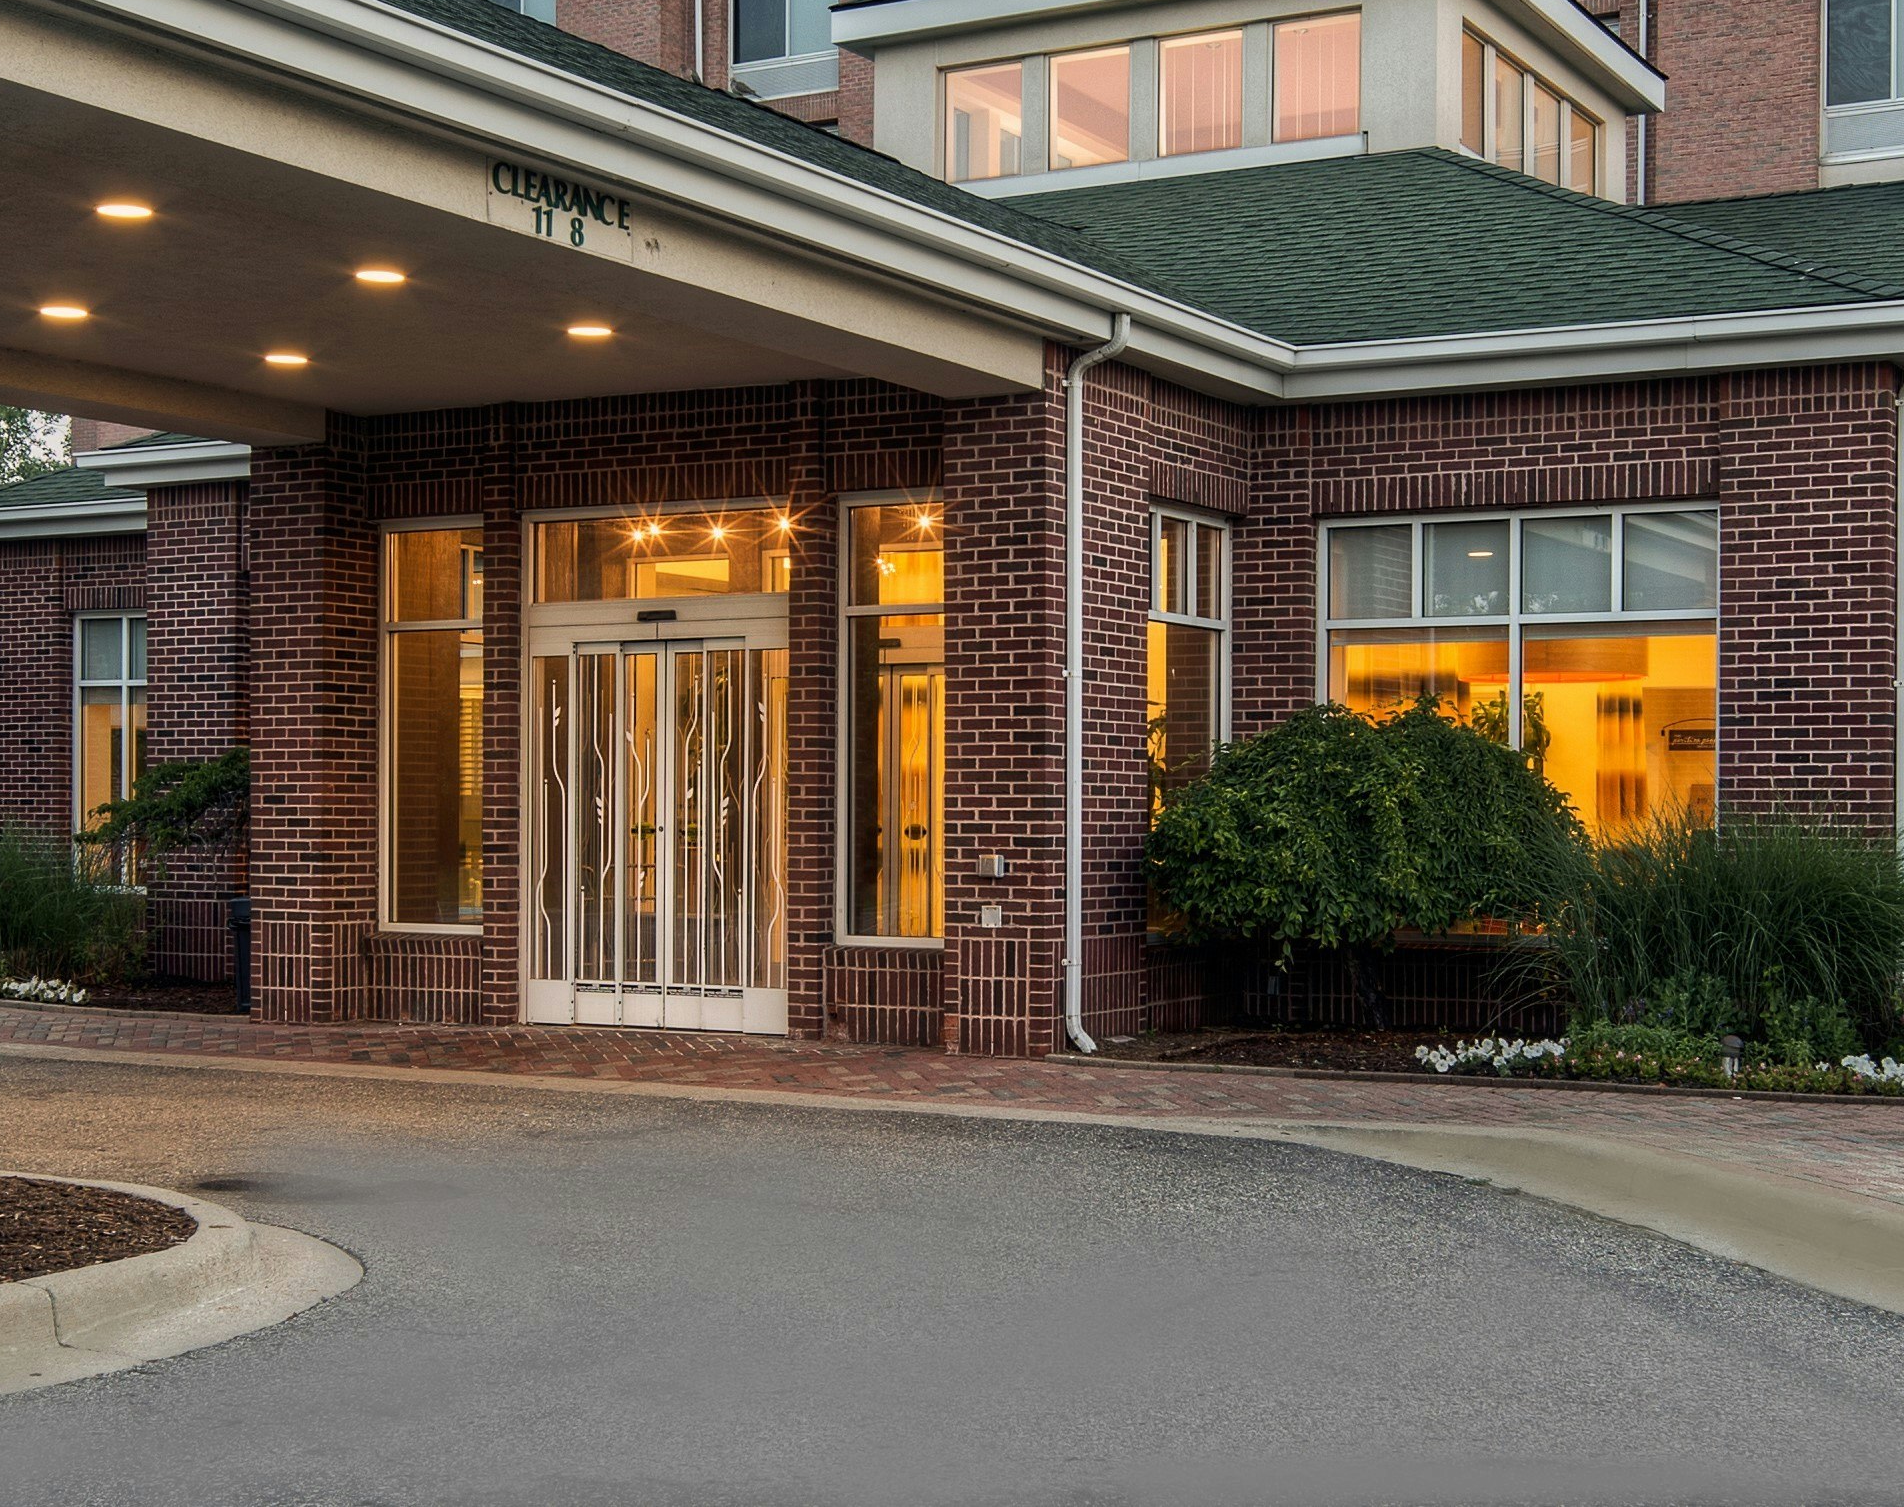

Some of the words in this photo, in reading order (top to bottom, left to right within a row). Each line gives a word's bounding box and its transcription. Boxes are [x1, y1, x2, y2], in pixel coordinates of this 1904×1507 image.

[492, 161, 631, 230] CLEARANCE
[532, 205, 553, 237] 11
[570, 218, 585, 247] 8
